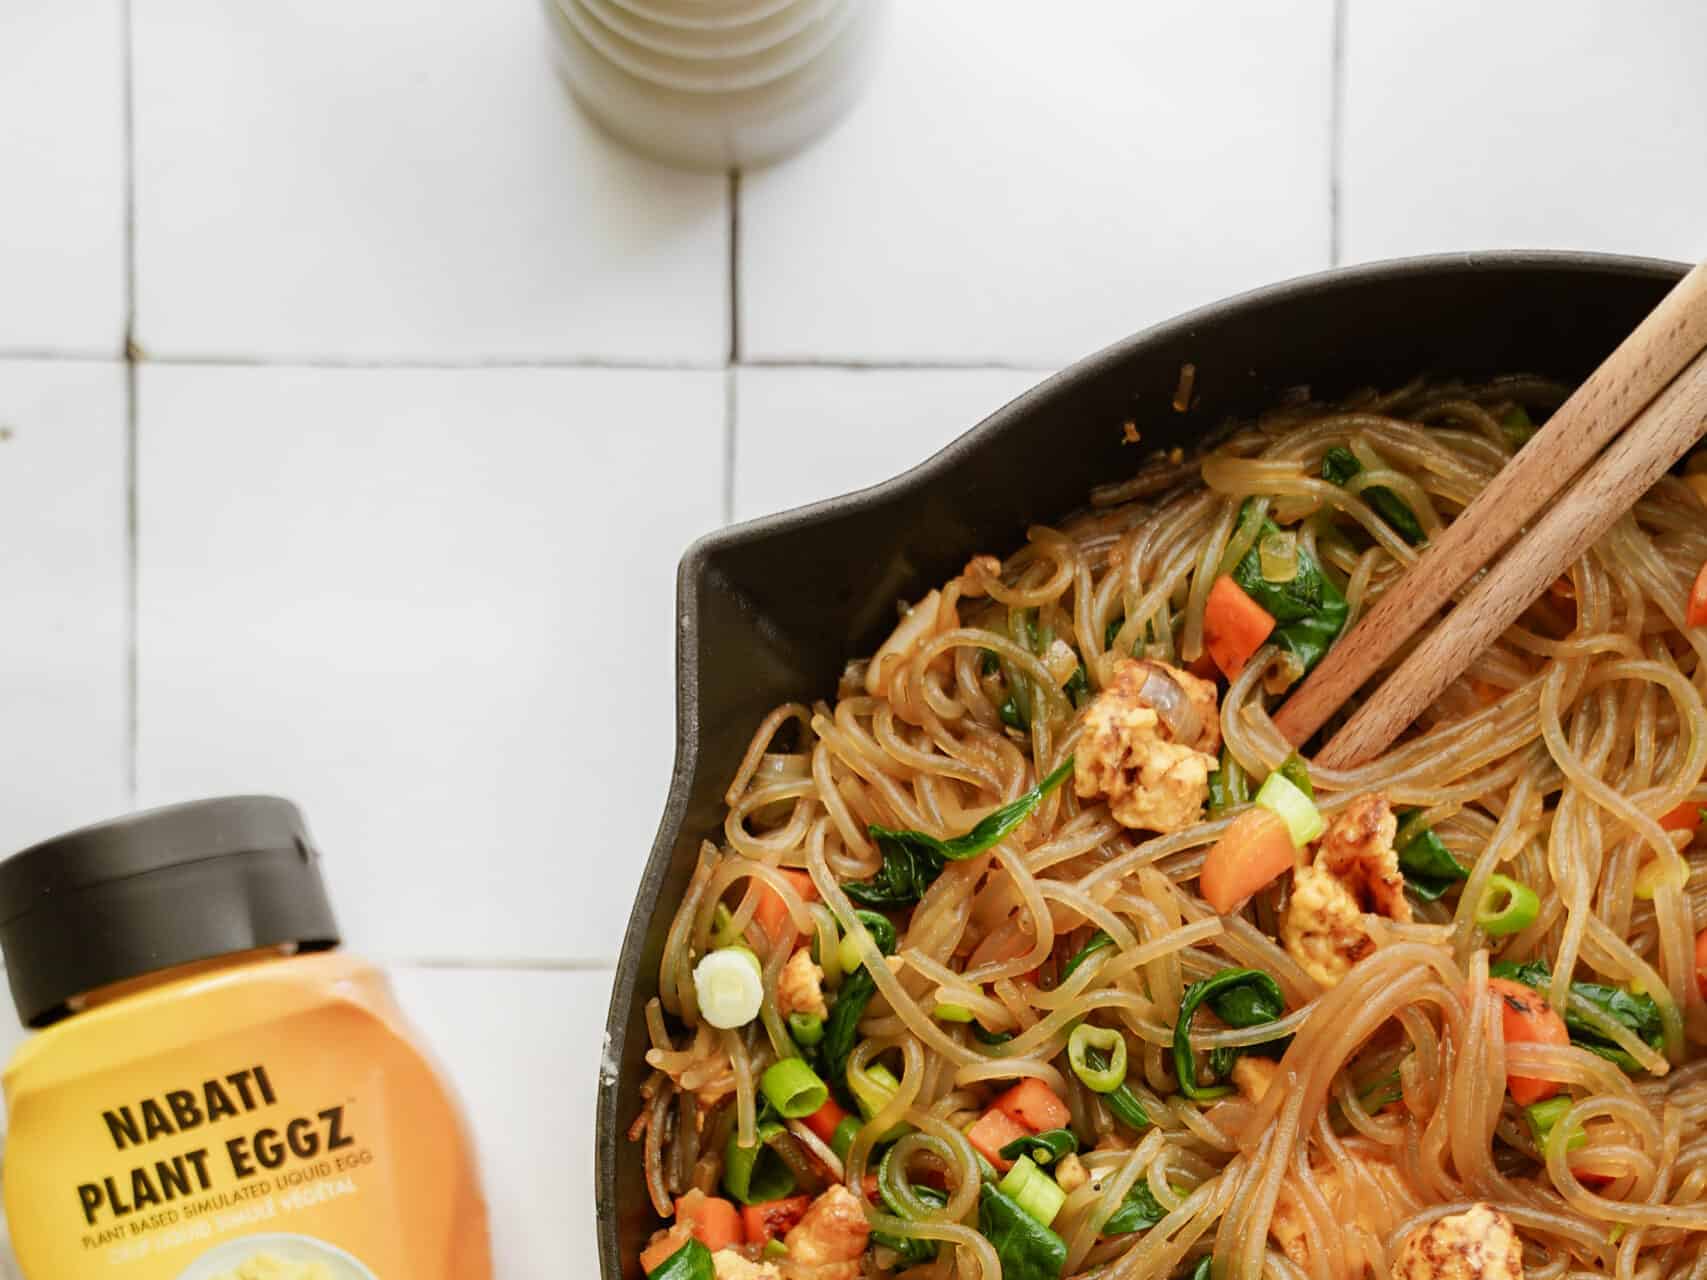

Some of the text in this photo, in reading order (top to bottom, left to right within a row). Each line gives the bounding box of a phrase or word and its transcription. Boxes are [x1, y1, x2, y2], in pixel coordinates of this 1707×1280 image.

[102, 1065, 278, 1151] NABATI
[77, 1148, 212, 1227] PLANT
[82, 1228, 128, 1249] PLANT
[130, 1209, 179, 1236] BASED
[183, 1182, 272, 1219] SIMULATED
[275, 1164, 332, 1192] LIQUID
[336, 1149, 374, 1172] EGG
